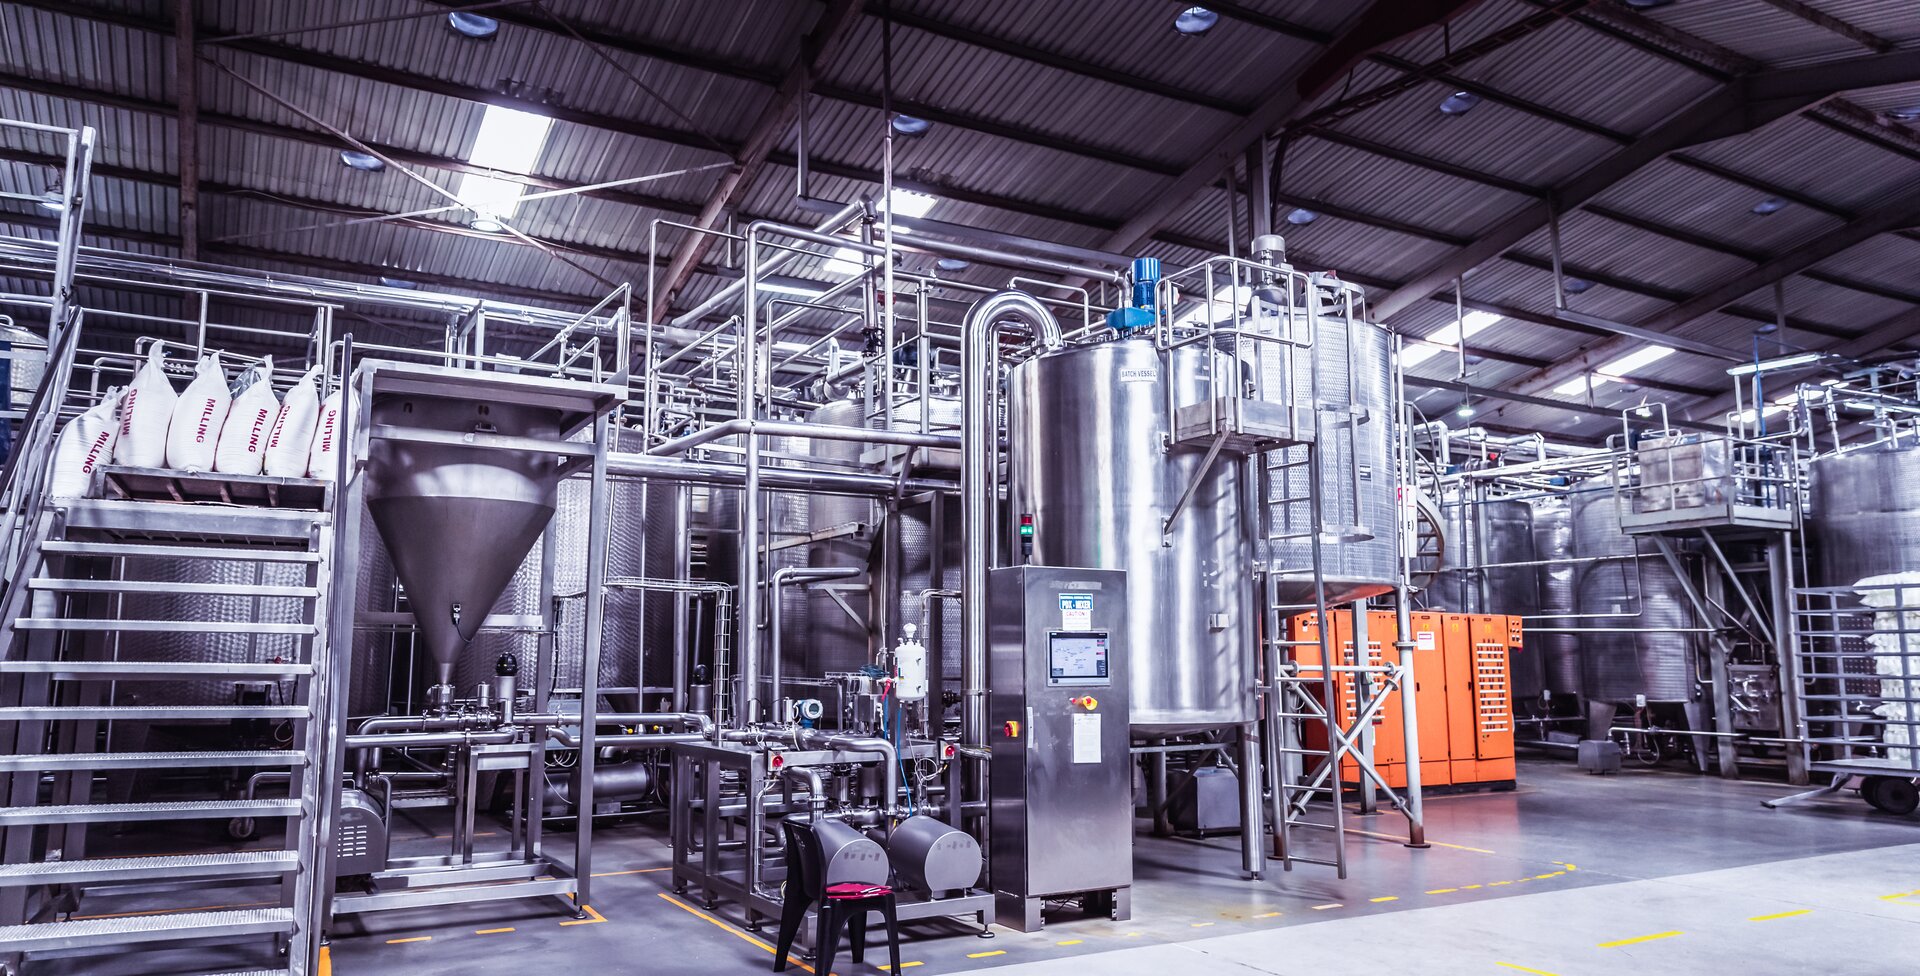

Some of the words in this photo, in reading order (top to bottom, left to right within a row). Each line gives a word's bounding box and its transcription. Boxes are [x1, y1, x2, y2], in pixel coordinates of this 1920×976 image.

[122, 388, 138, 436] MILLING
[196, 398, 216, 443] MILLING
[248, 408, 268, 453] MILLING
[270, 405, 291, 448] MILLING
[322, 409, 337, 452] MILLING
[82, 431, 110, 474] MILLING
